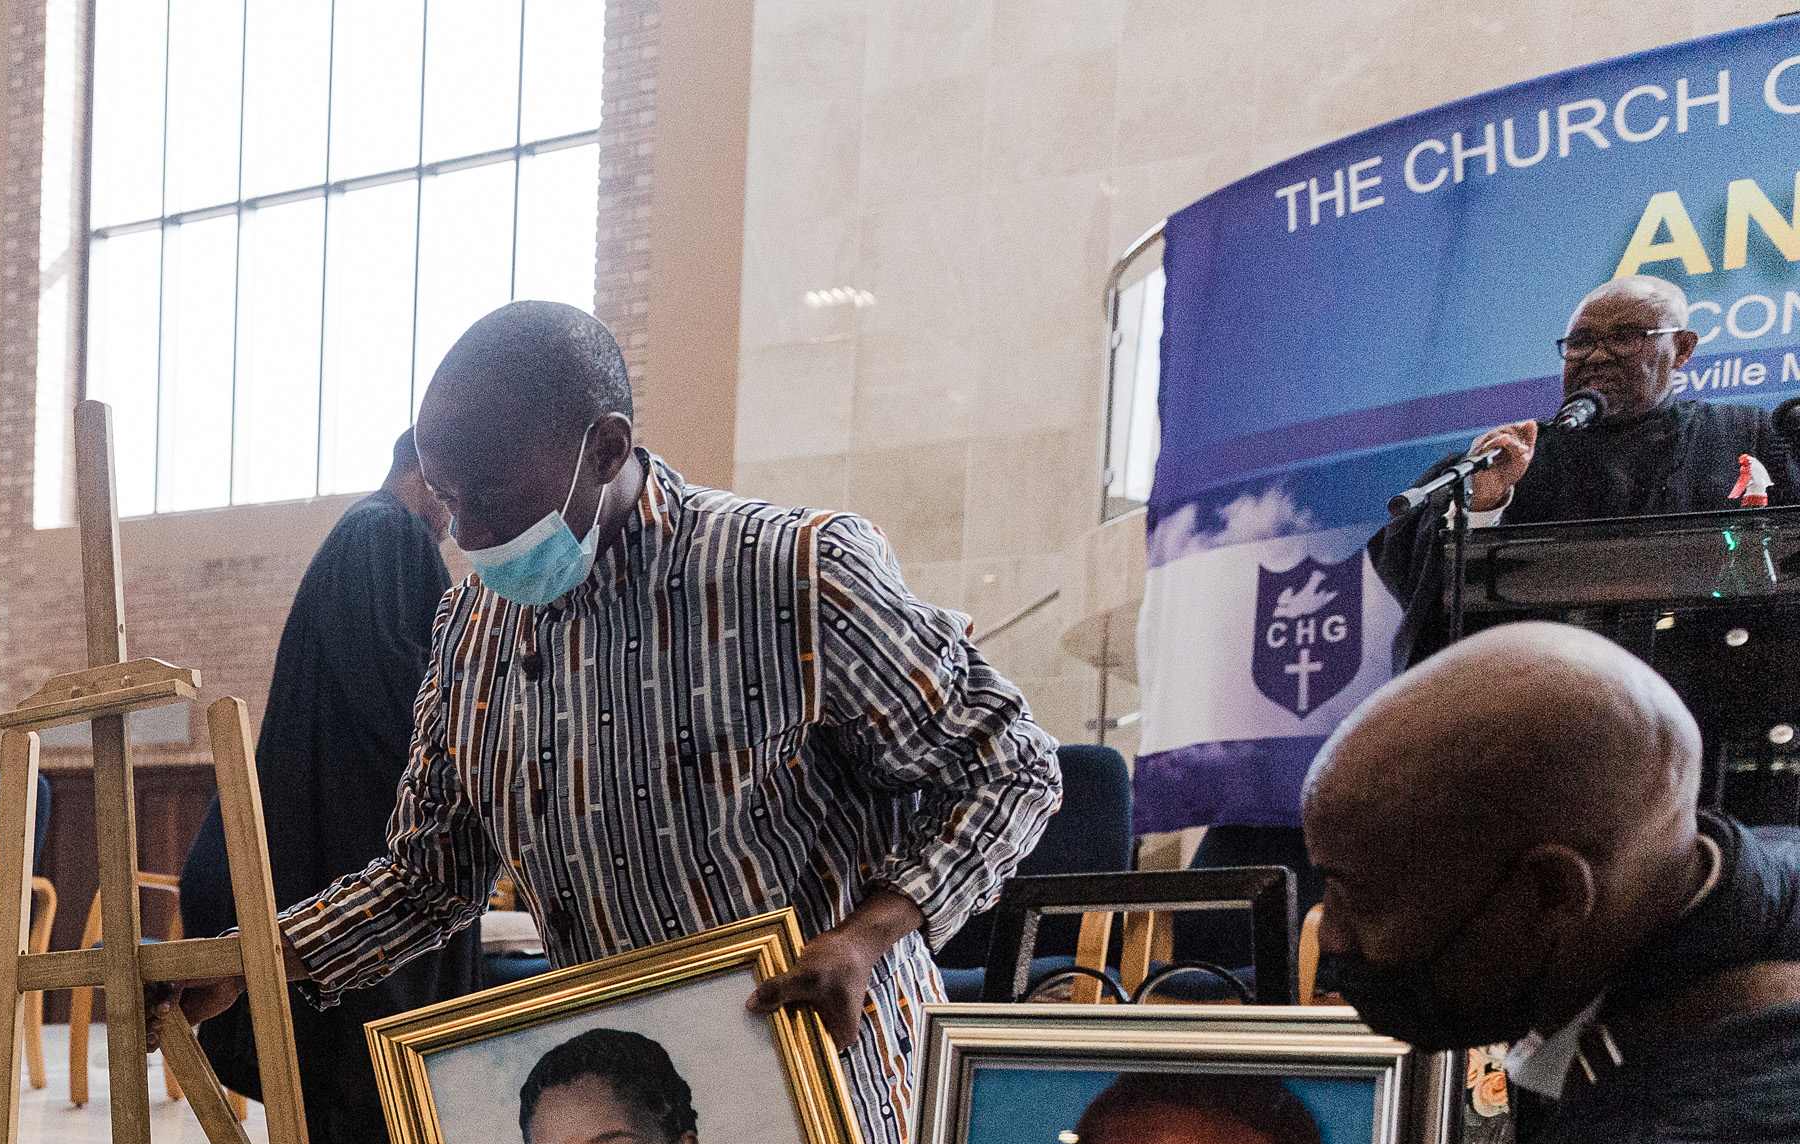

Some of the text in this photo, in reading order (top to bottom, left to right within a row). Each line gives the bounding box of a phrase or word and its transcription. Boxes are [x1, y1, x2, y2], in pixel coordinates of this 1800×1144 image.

[1274, 156, 1385, 233] THE
[1404, 67, 1731, 194] CHURCH
[1266, 614, 1347, 648] CHG
